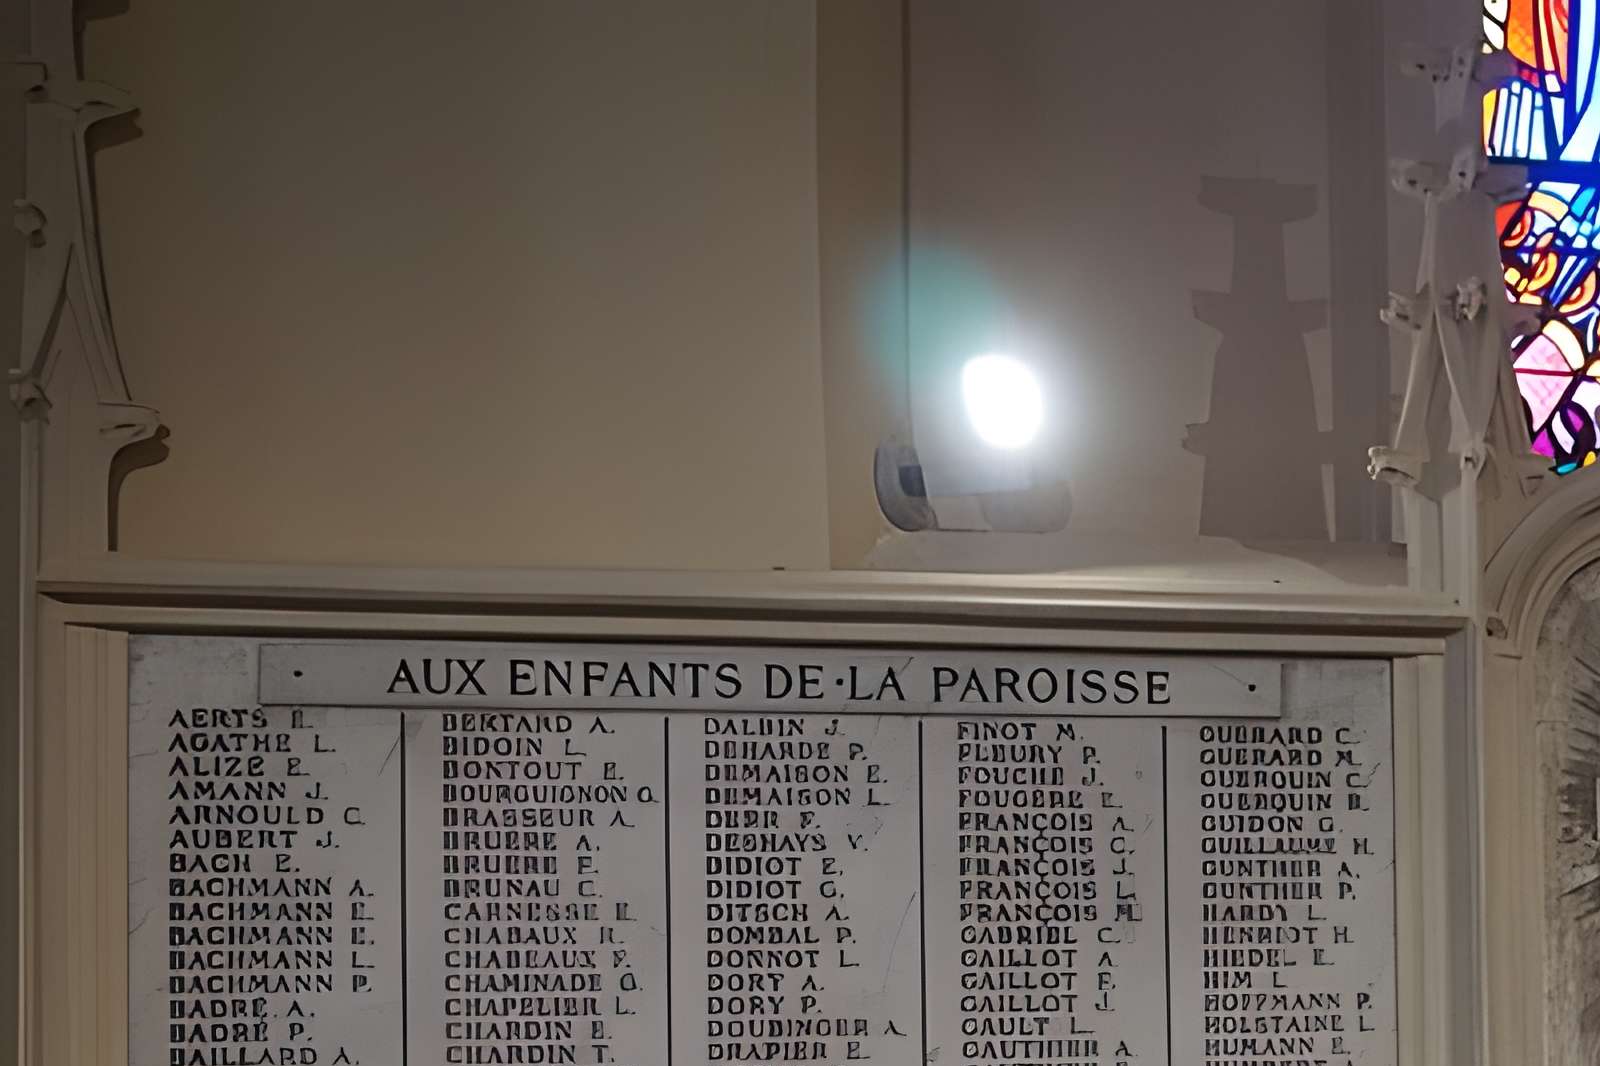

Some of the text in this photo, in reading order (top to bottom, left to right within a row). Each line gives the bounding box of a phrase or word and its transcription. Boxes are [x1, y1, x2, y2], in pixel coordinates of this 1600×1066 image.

[387, 659, 1171, 705] AUX ENFANTS DE LA PAROISSE
[957, 721, 1043, 742] FINOT
[168, 779, 286, 801] AMANN
[169, 804, 324, 825] ARNOULD
[169, 829, 298, 849] AUBERT
[170, 853, 251, 873] BACH
[706, 856, 802, 876] DIDIOT
[707, 880, 802, 899] DIDIOT
